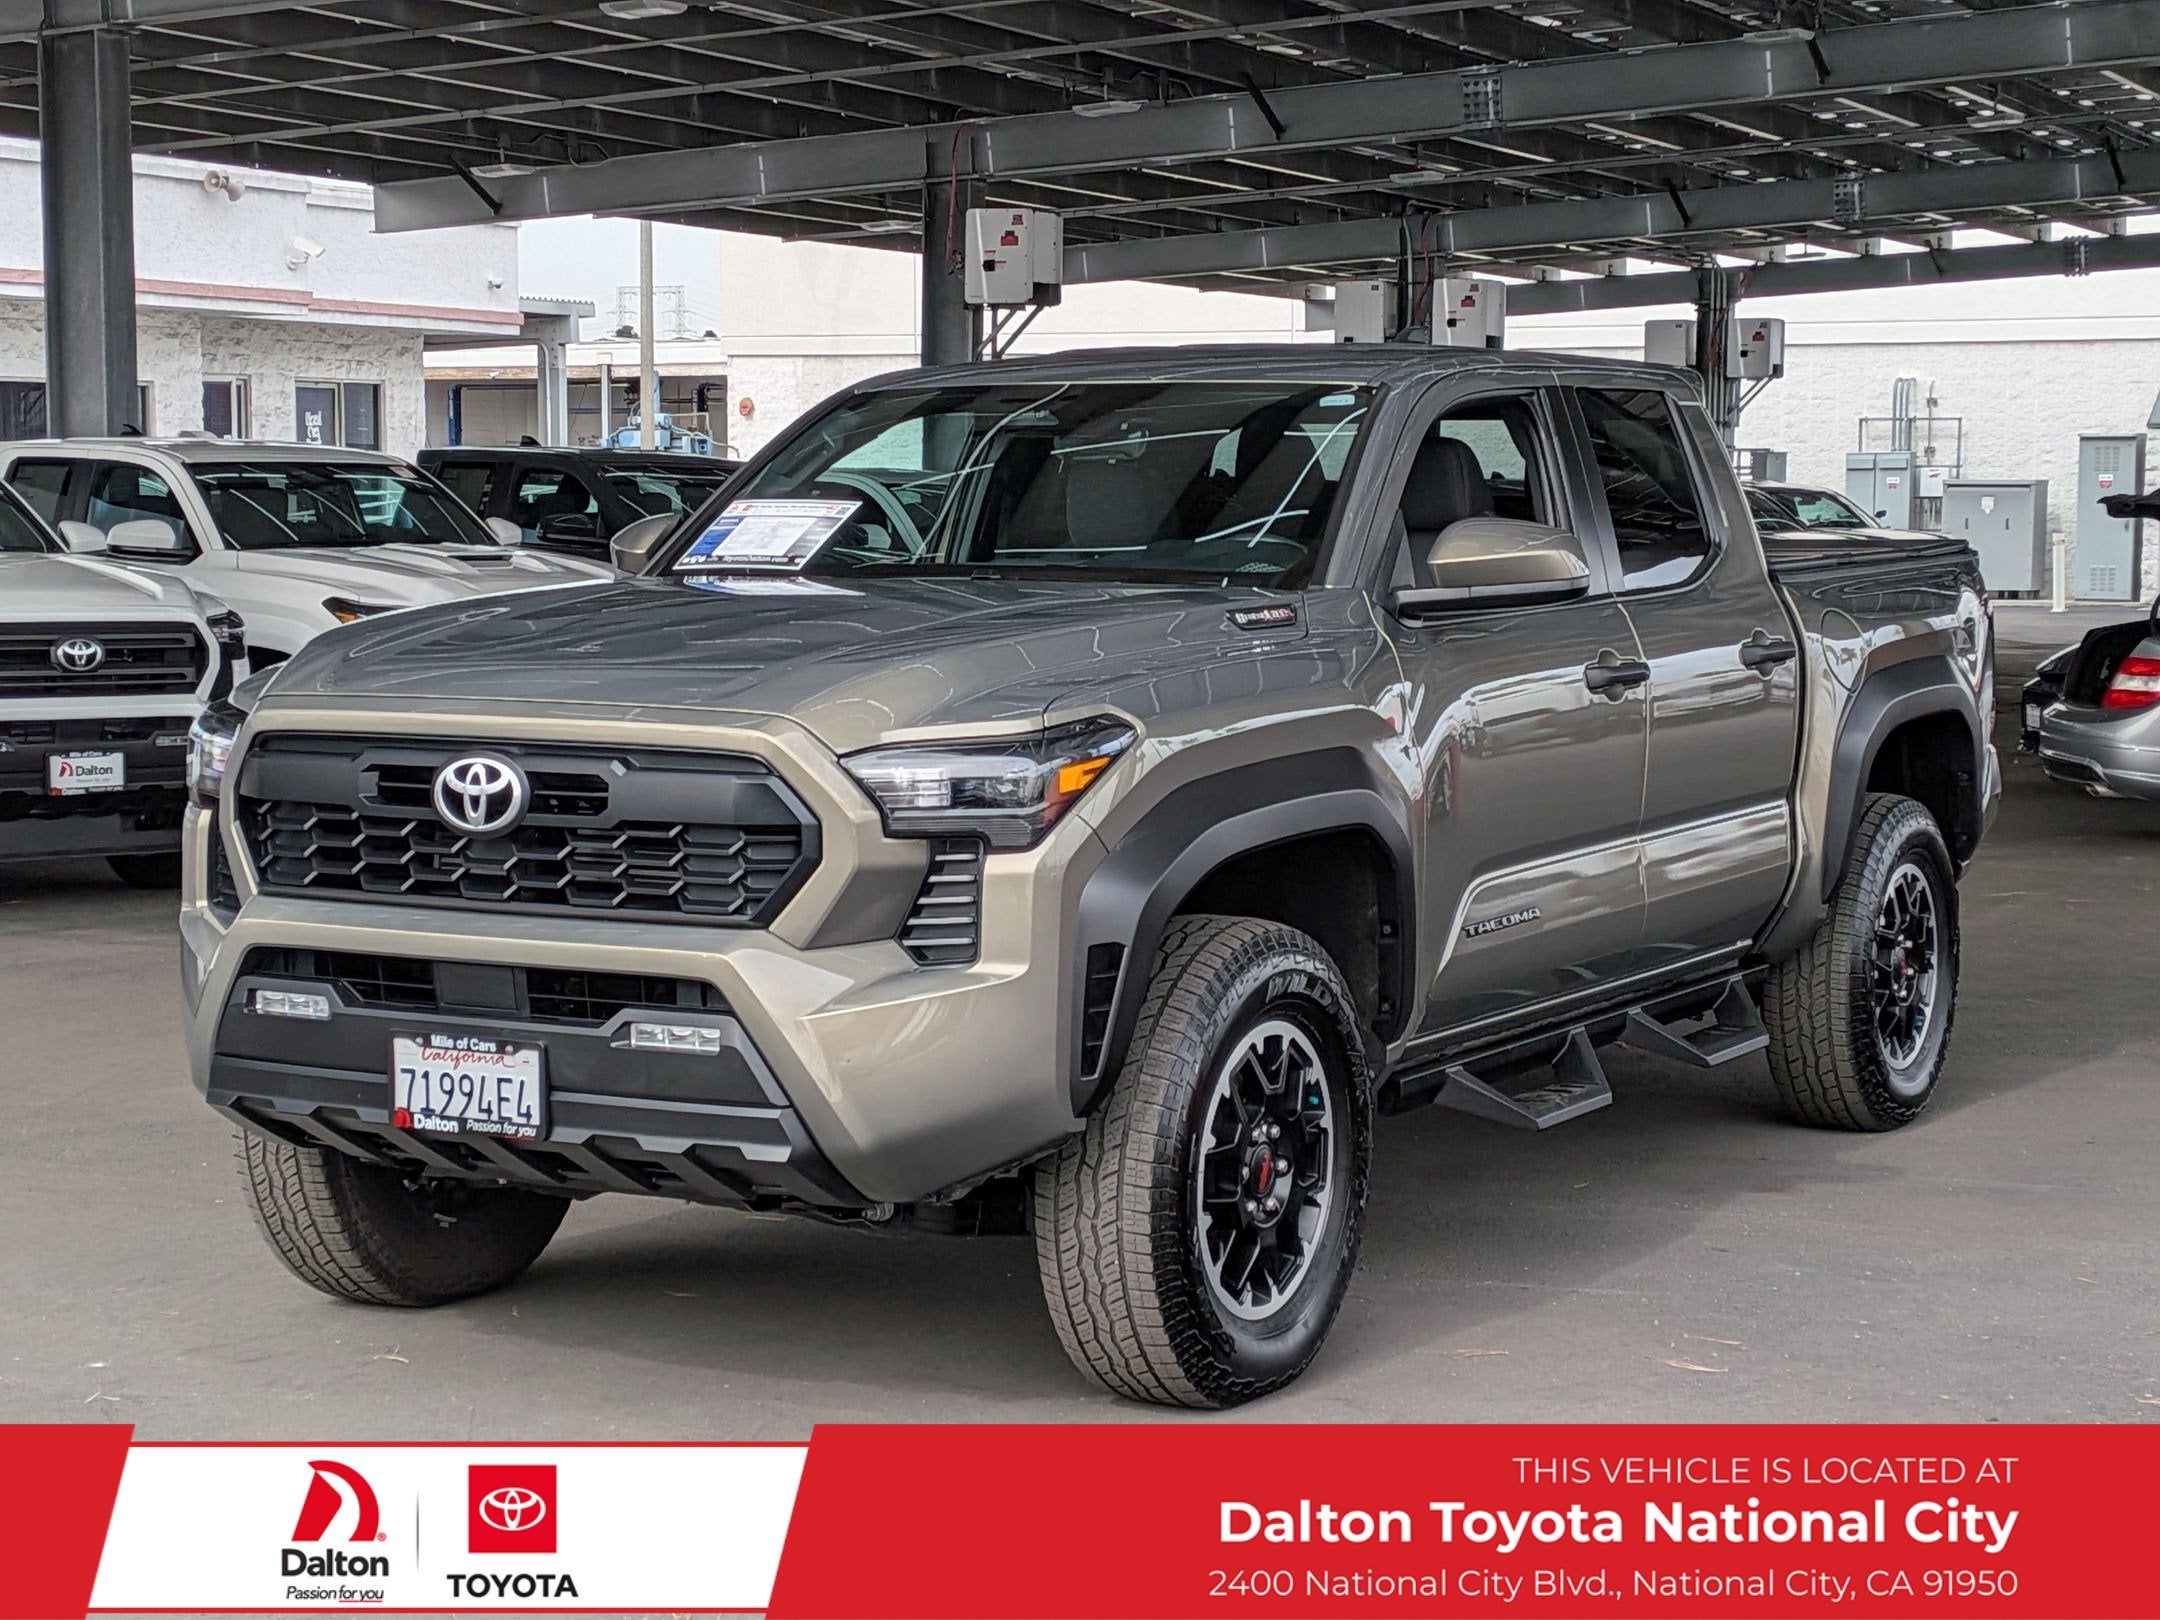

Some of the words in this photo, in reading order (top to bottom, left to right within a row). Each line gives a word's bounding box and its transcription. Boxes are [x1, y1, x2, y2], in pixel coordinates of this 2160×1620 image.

[75, 765, 113, 777] Dalton
[1464, 907, 1541, 937] TACOMA
[430, 1034, 455, 1049] Mile
[456, 1037, 468, 1049] of
[470, 1039, 497, 1053] Cars
[421, 1047, 516, 1070] California
[400, 1068, 533, 1124] 71994E4
[413, 1114, 459, 1133] Dalton
[466, 1118, 502, 1133] Passion
[502, 1121, 517, 1135] for
[517, 1125, 537, 1138] you
